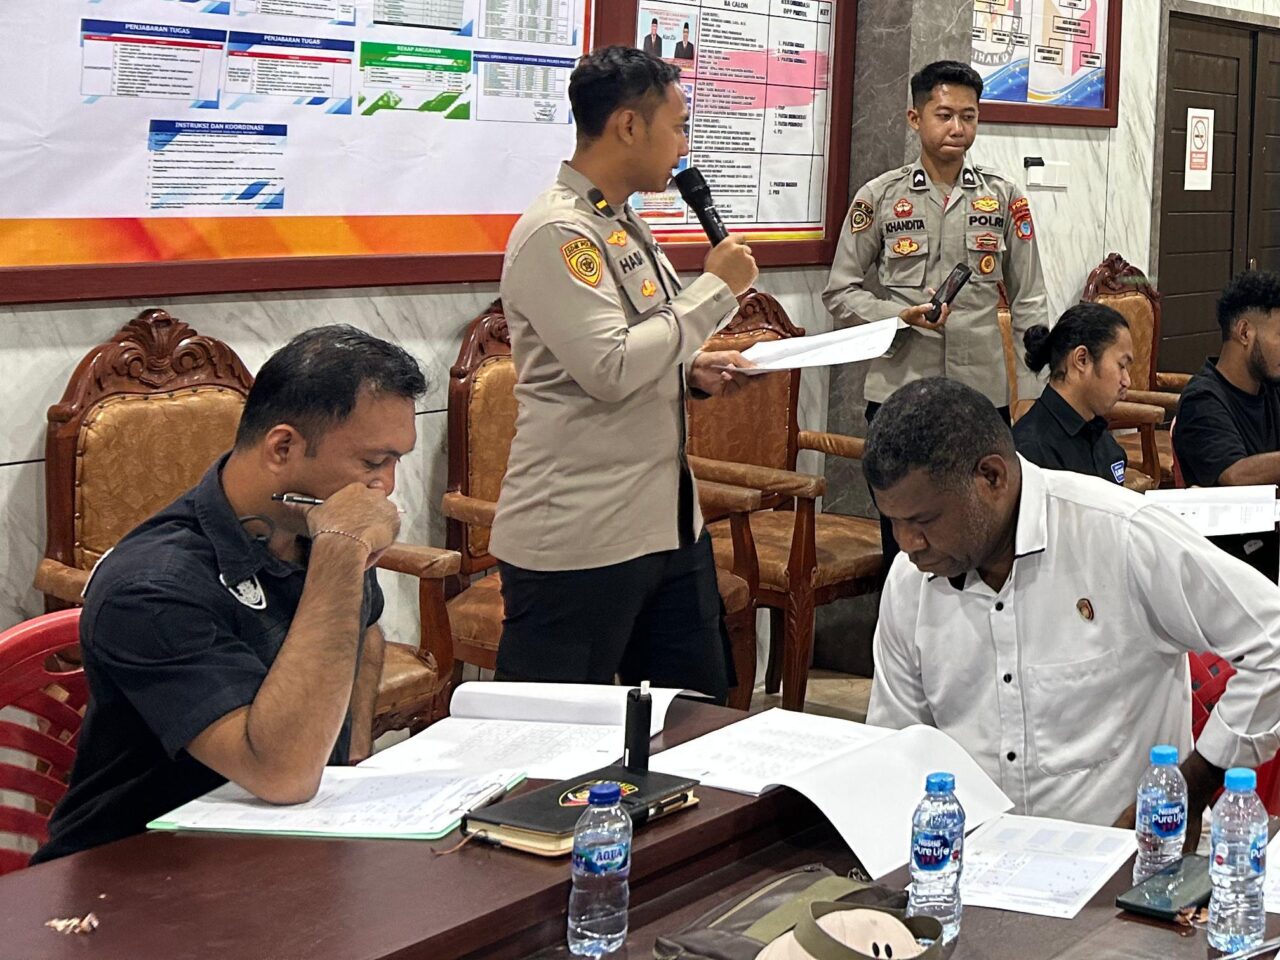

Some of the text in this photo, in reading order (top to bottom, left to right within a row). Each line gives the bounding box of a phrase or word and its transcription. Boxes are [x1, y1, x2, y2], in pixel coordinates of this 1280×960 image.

[732, 1, 749, 9] CALON
[125, 23, 190, 35] PENJABARAN TUGAS
[263, 35, 300, 44] PENJABARAN
[175, 121, 209, 129] INSTRUKSI
[1152, 813, 1173, 824] Pure
[596, 848, 622, 861] AQUA
[913, 844, 950, 860] Pure Life
